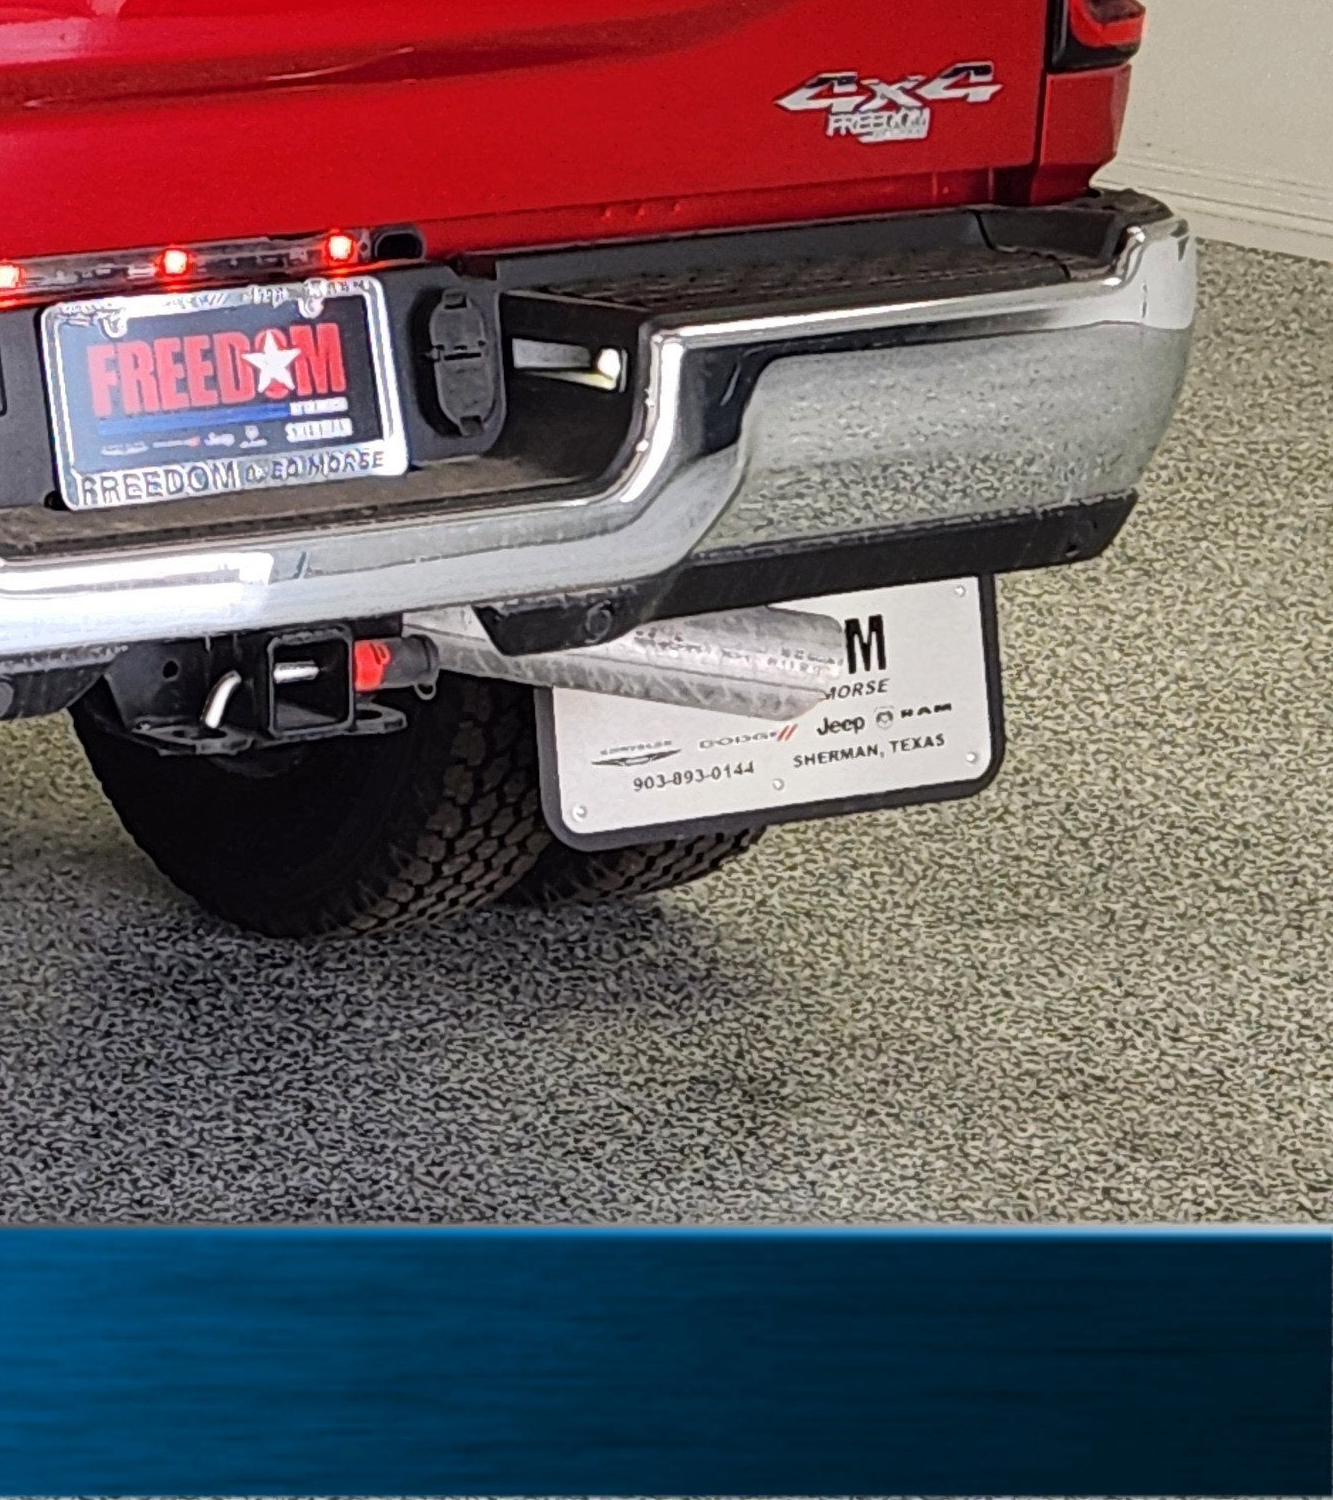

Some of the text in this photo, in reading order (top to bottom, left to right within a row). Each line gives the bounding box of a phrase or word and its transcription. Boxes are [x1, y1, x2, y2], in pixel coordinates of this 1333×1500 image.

[825, 107, 931, 138] FREEDOM
[85, 322, 347, 418] FREEDOM
[80, 456, 237, 506] FREEDOM
[816, 716, 865, 735] Jeep
[793, 732, 946, 768] SHERMAN, TEXAS
[633, 760, 754, 792] 903-893-0144
